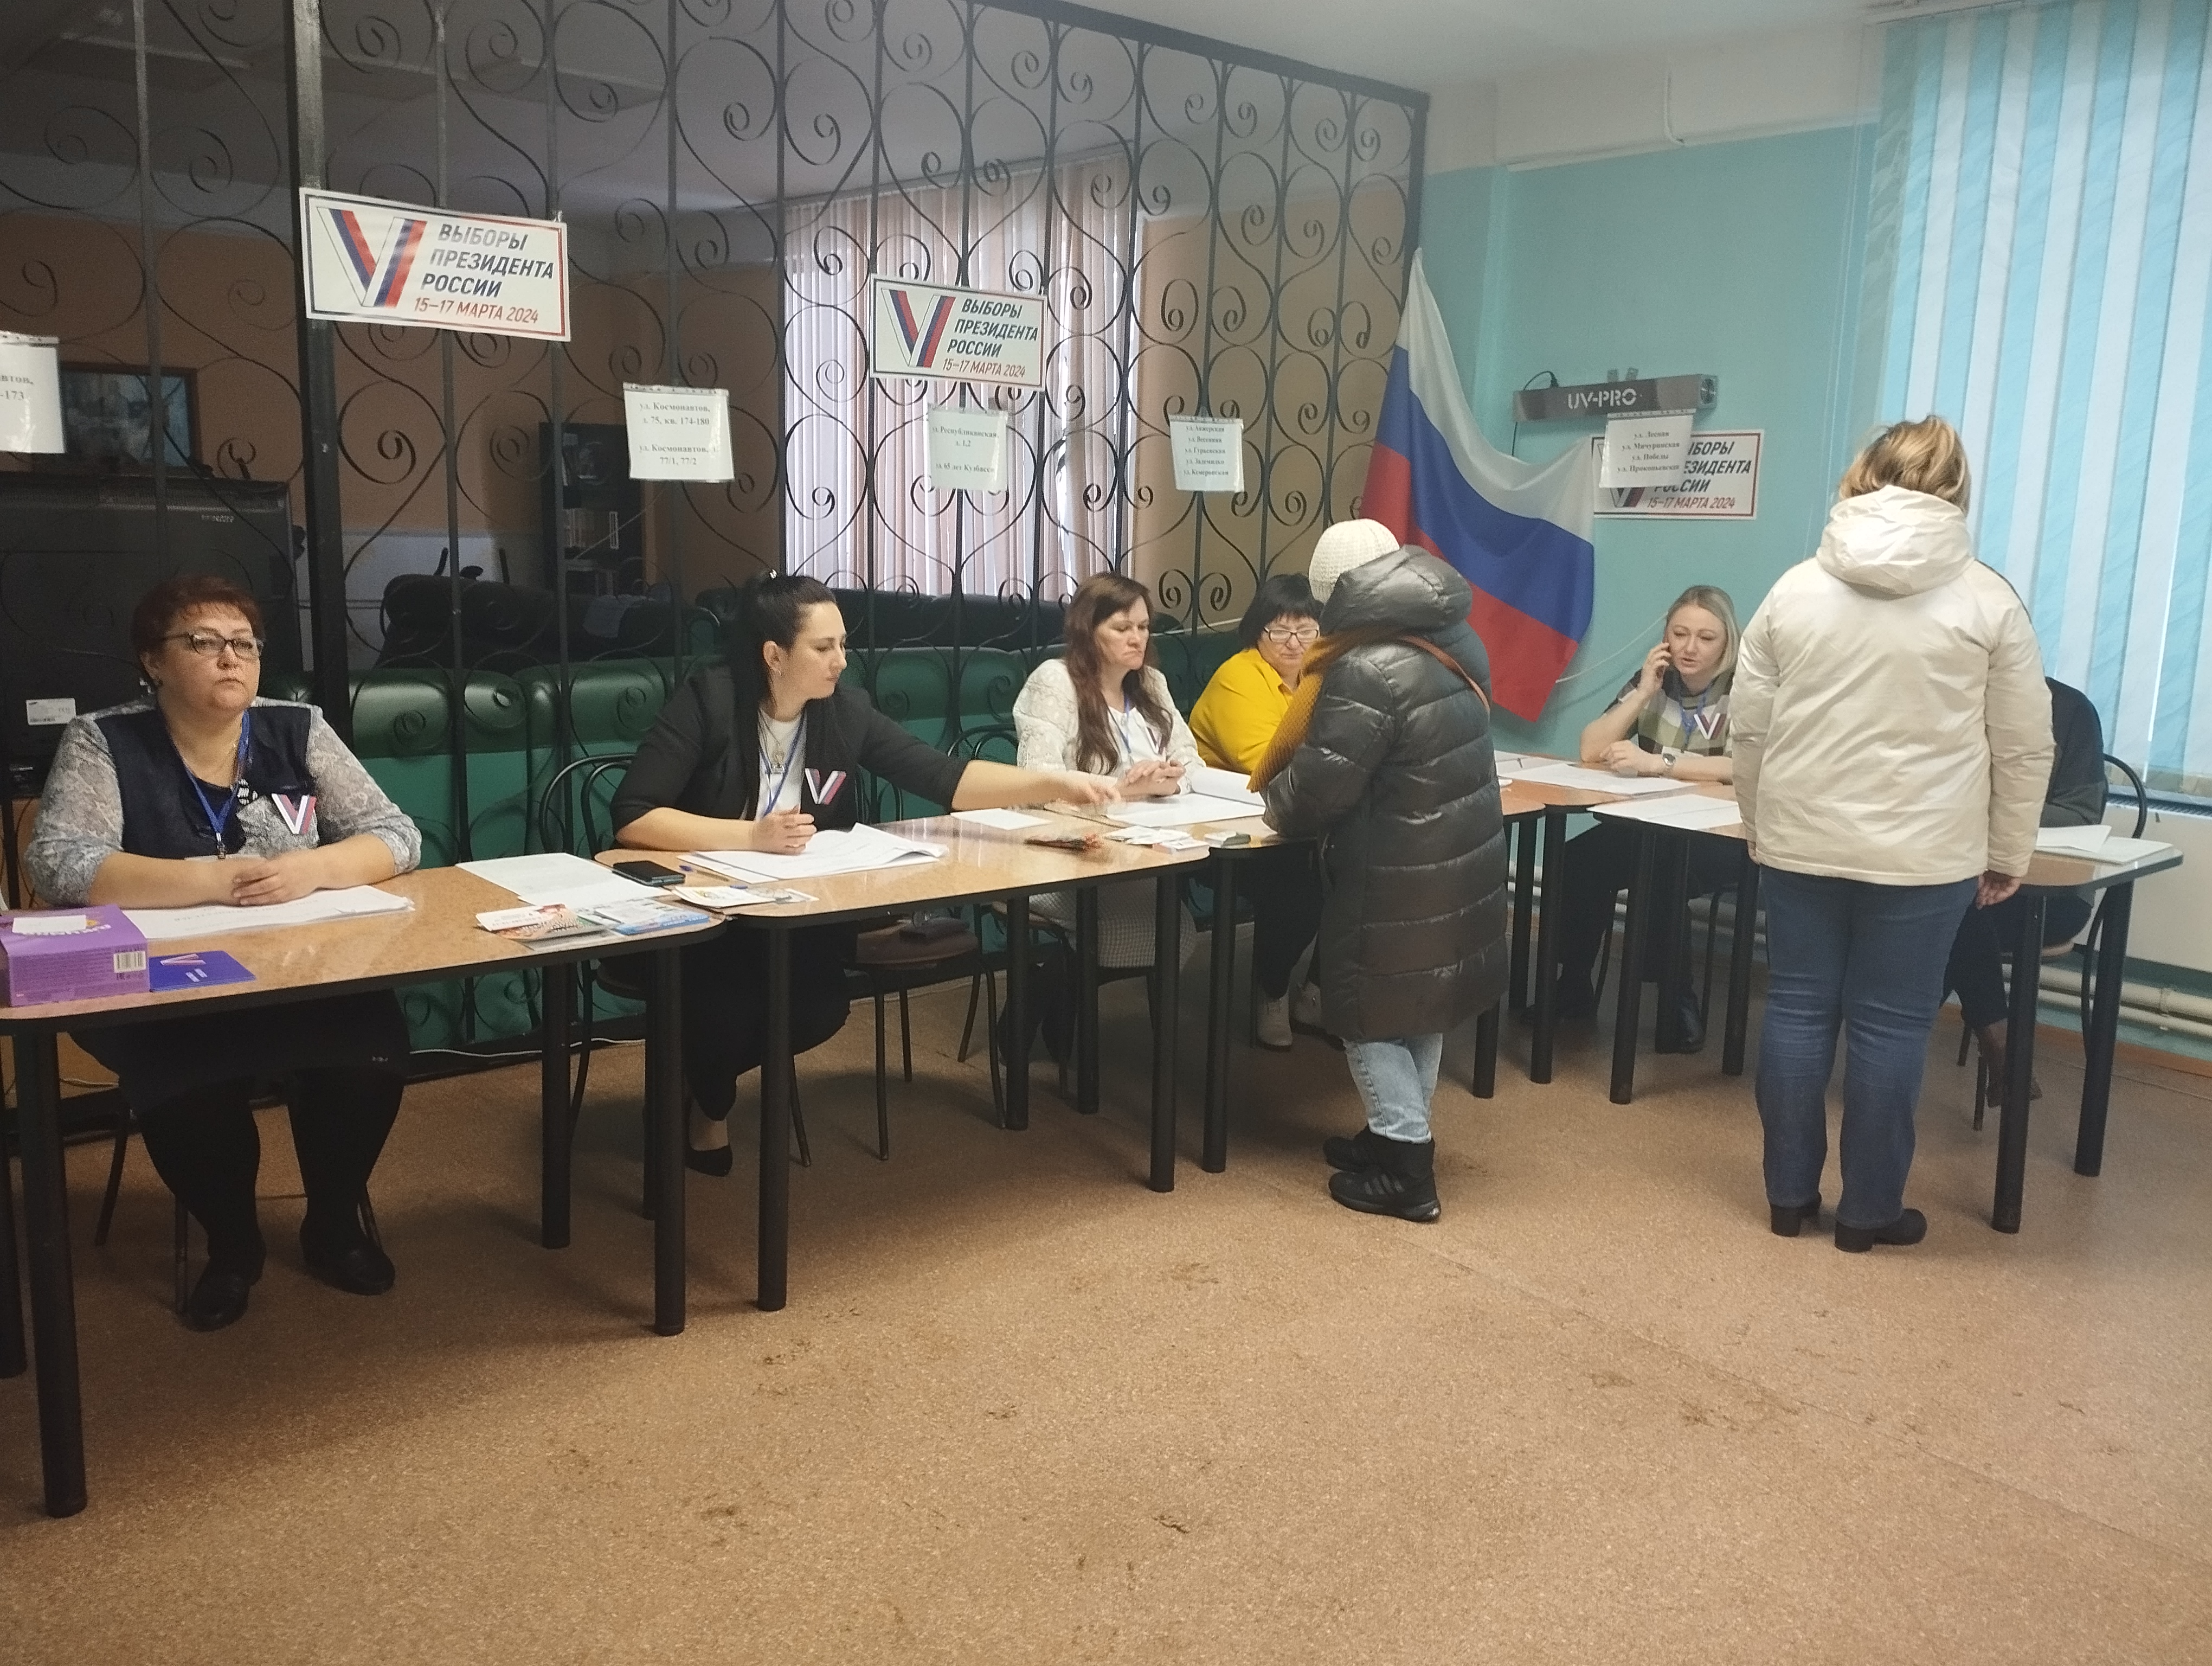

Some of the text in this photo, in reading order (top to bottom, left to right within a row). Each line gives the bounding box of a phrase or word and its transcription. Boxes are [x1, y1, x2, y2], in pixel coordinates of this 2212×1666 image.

[438, 223, 529, 251] ВЫБОРЫ
[429, 248, 554, 280] ПРЕЗИДЕНТА
[421, 273, 503, 298] РОССИИ
[457, 303, 502, 320] МАРТА
[506, 306, 538, 323] 2024
[961, 299, 1023, 318] ВЫБОРЫ
[954, 319, 1038, 342] ПРЕЗИДЕНТА
[947, 339, 1002, 358] РОССИИ
[969, 362, 1002, 375] МАРТА
[1003, 364, 1026, 377] 2024
[653, 402, 710, 412] Космонавтов,
[1568, 387, 1637, 409] UV-PRO
[680, 417, 709, 425] 174-180
[652, 445, 709, 453] Космонавтов,
[660, 457, 678, 465] 77/1,
[1674, 497, 1709, 508] МАРТА
[1709, 497, 1735, 508] 2024
